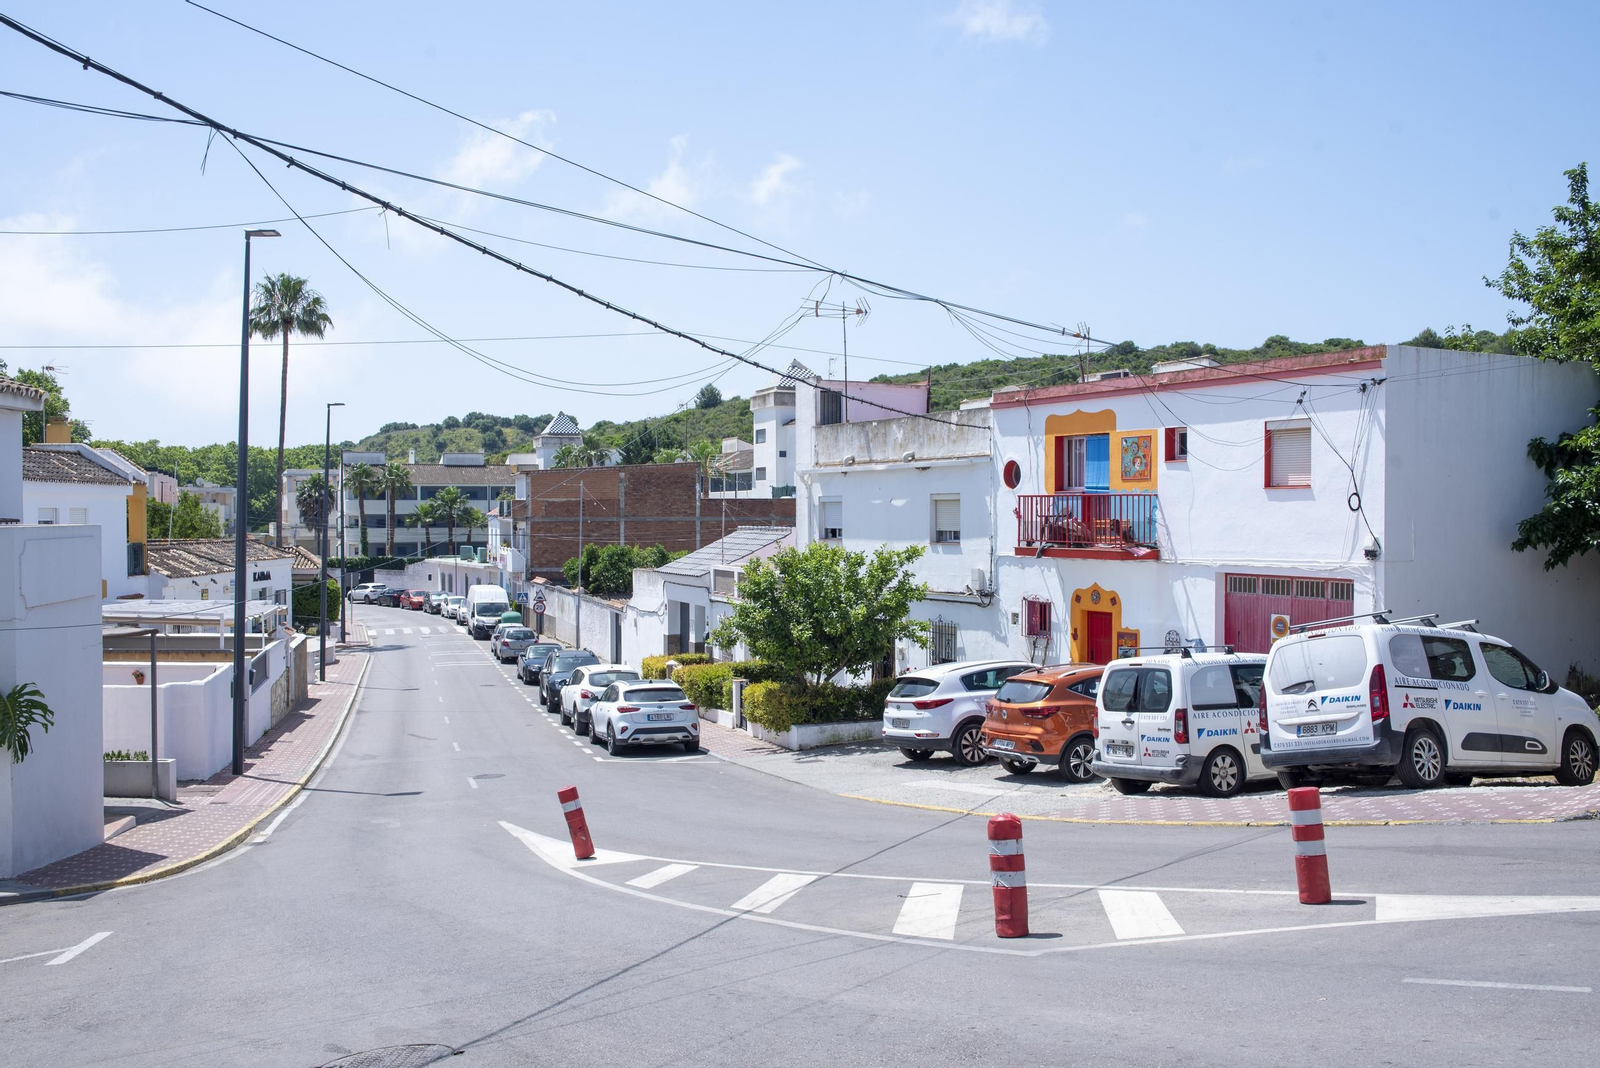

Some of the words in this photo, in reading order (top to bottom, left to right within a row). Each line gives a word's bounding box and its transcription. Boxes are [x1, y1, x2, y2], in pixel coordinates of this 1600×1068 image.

[1394, 677, 1410, 686] AIRE
[1413, 679, 1470, 691] ACONDICIONADO
[1329, 695, 1361, 704] DAIKIN
[1453, 702, 1481, 711] DAIKIN
[1193, 711, 1209, 719] AIRE
[1206, 728, 1238, 737] DAIKIN
[1302, 725, 1318, 734] 6883
[1321, 723, 1335, 732] KPM
